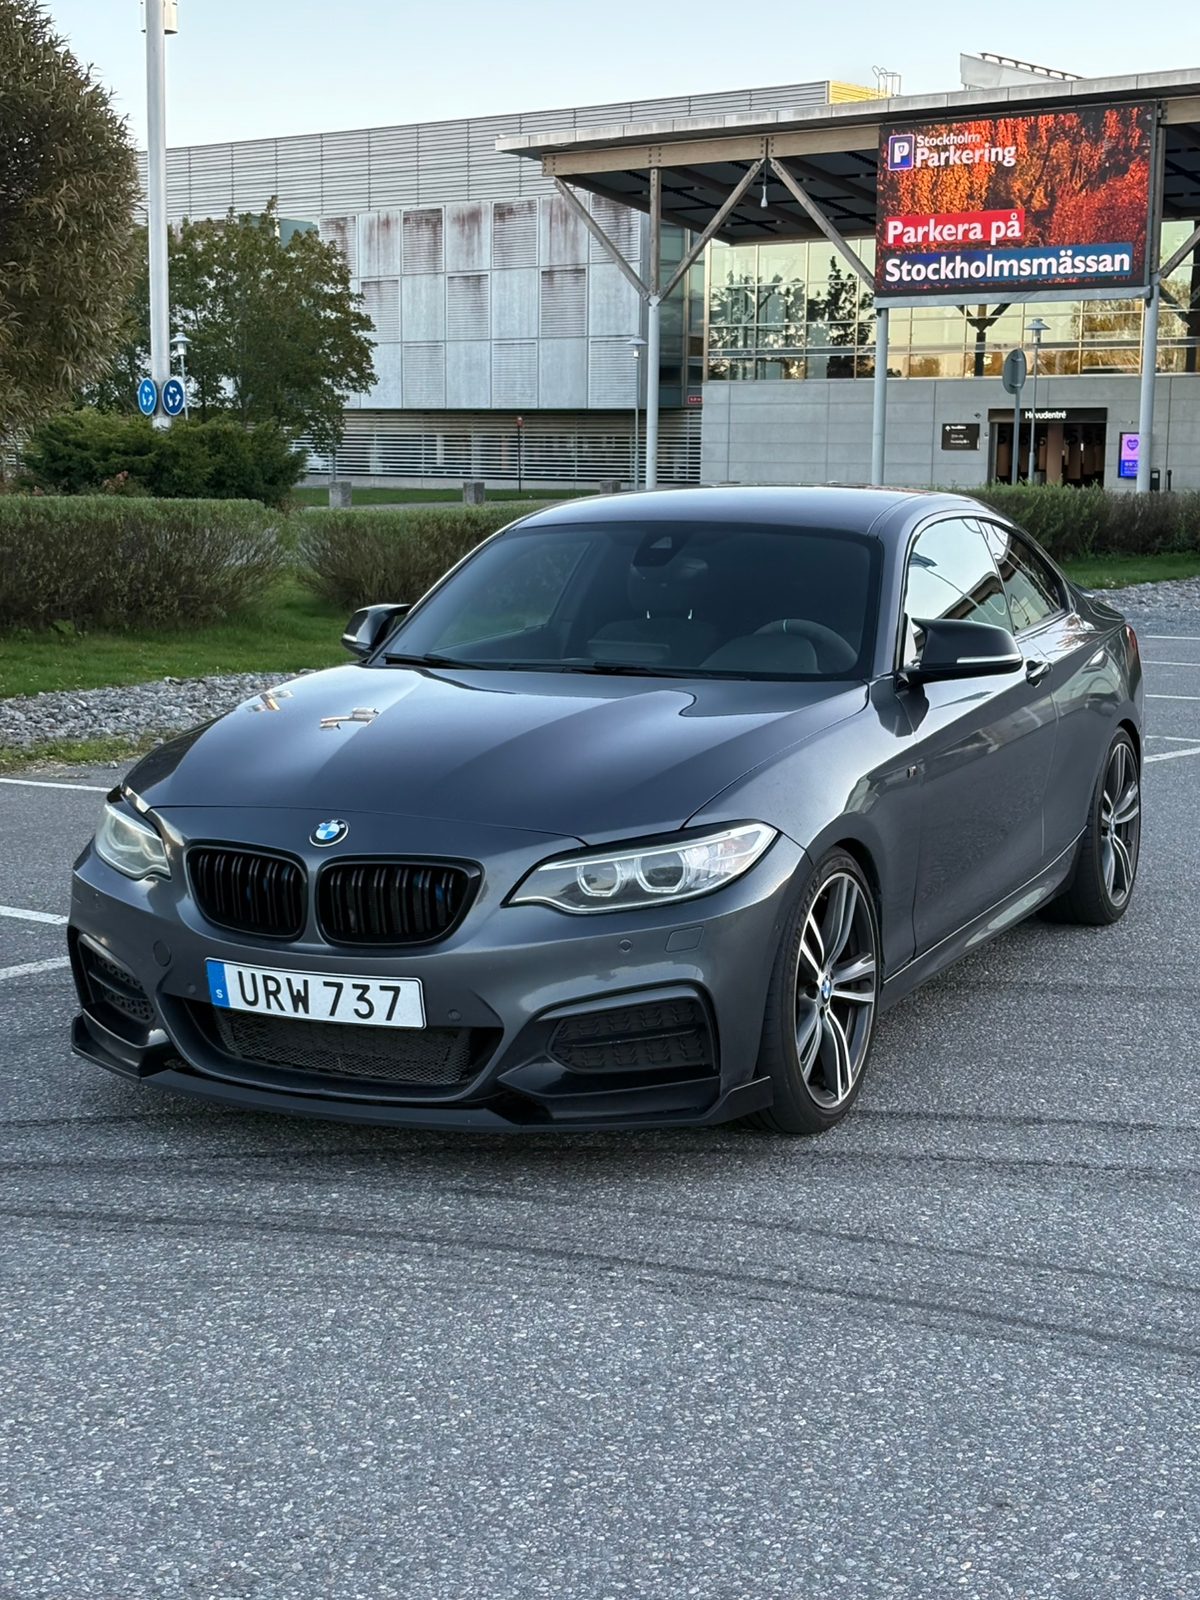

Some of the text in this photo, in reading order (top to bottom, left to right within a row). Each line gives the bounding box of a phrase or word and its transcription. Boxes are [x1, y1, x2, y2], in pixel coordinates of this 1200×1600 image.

[916, 132, 981, 147] Stockholm
[893, 142, 910, 164] P
[915, 142, 1017, 168] Parkering
[887, 212, 1022, 246] Parkera på
[885, 249, 1131, 283] Stockholmsmässan
[215, 989, 224, 999] S
[237, 970, 402, 1021] URW 737
